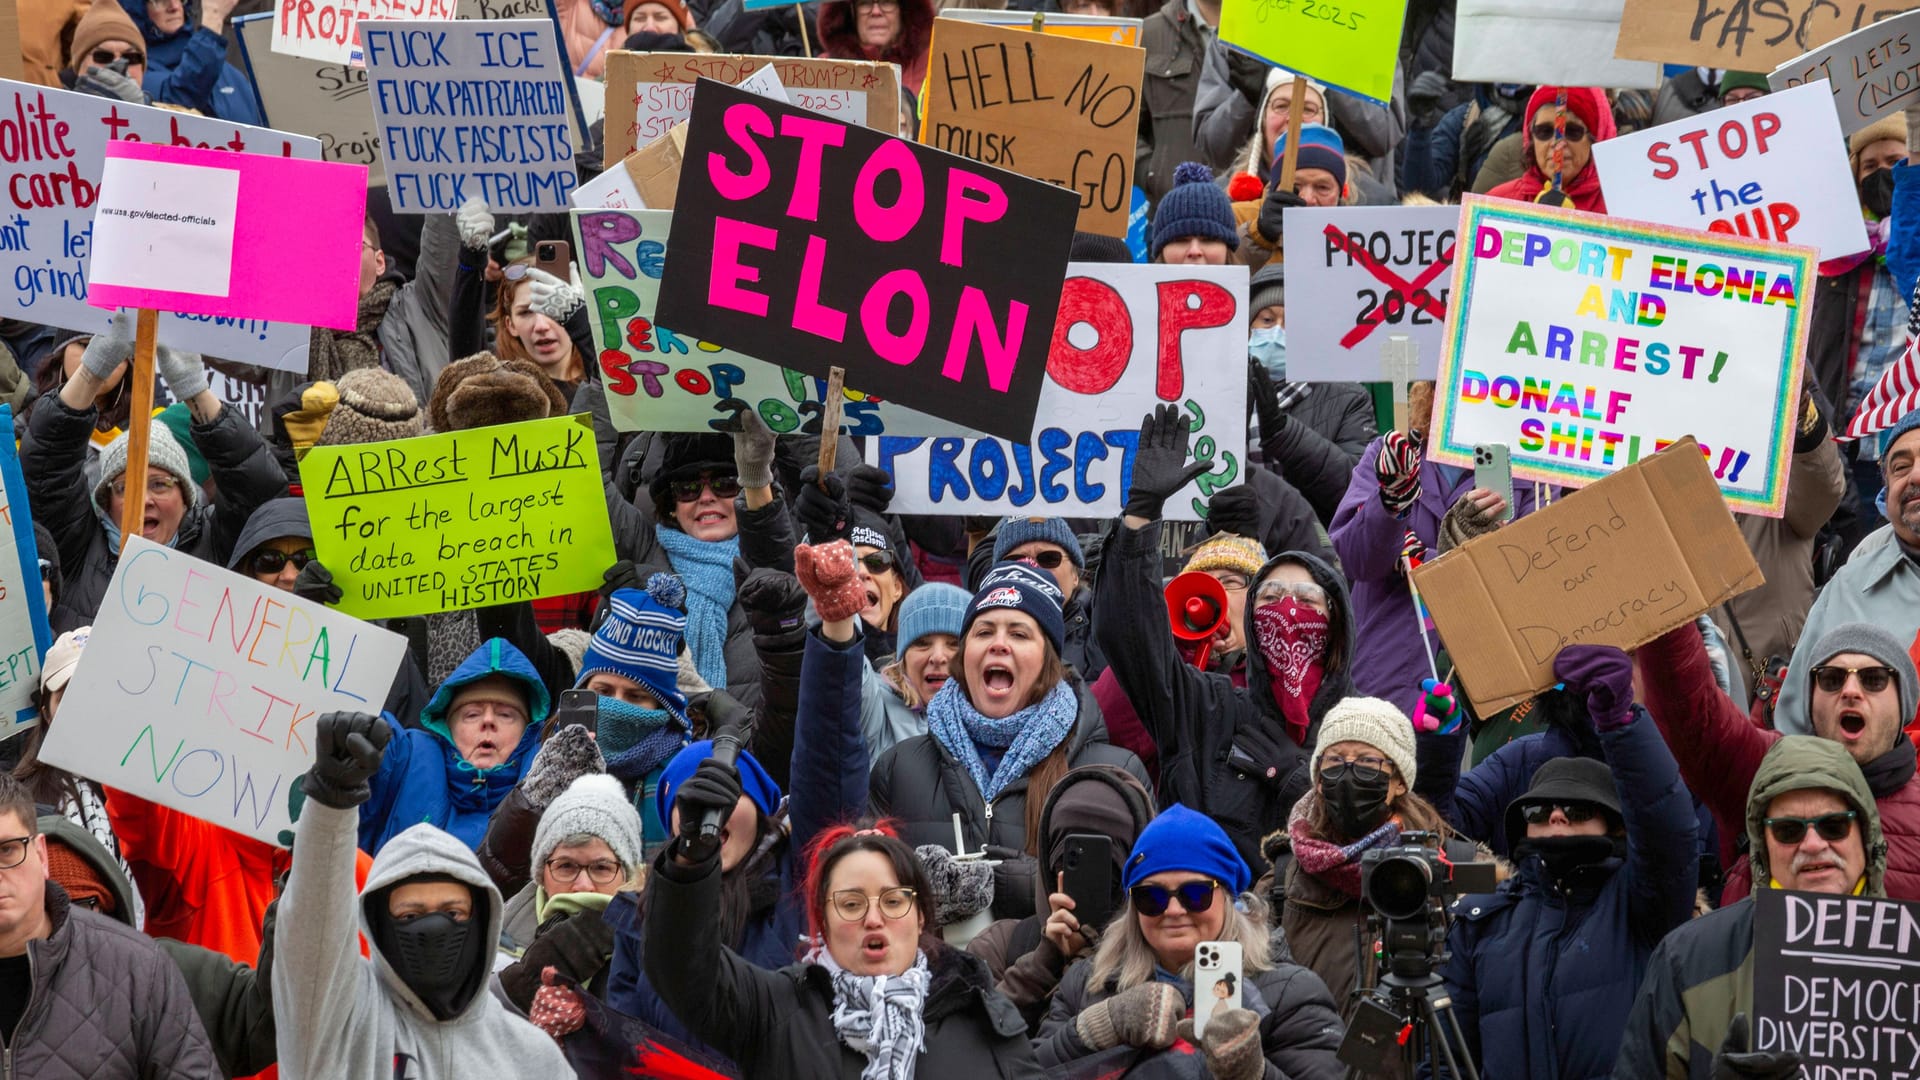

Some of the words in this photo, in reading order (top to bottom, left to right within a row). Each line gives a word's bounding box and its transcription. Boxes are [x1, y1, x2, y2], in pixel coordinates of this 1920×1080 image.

[479, 0, 543, 19] Back!
[1301, 0, 1367, 31] 2025
[368, 31, 451, 68] FUCK
[475, 31, 545, 69] ICE
[677, 59, 756, 84] STOP
[774, 63, 856, 89] TRUMP!
[1853, 32, 1912, 80] LETS
[377, 79, 446, 116] FUCK
[943, 41, 1055, 112] HELL
[1064, 64, 1136, 129] NO
[386, 126, 452, 163] FUCK
[454, 124, 573, 165] FASCISTS
[1647, 112, 1782, 181] STOP
[9, 161, 101, 211] carb
[395, 172, 468, 209] FUCK
[472, 170, 577, 208] TRUMP
[707, 103, 1009, 268] STOP
[1071, 149, 1126, 213] GO
[1690, 178, 1764, 216] the
[1473, 225, 1633, 282] DEPORT
[1649, 254, 1798, 309] ELONIA
[707, 216, 1030, 393] ELON
[1575, 284, 1667, 328] AND
[600, 348, 746, 399] STOP
[1504, 320, 1730, 384] ARREST!
[1460, 368, 1633, 425] DONALF
[877, 426, 1142, 509] PROJECT
[335, 505, 391, 541] for
[405, 498, 453, 531] the
[468, 480, 565, 523] largest
[350, 541, 416, 574] data
[438, 521, 535, 561] breach
[549, 521, 573, 545] in
[1497, 497, 1627, 585] Defend
[362, 571, 447, 601] UNITED
[460, 552, 559, 585] STATES
[441, 573, 542, 609] HISTORY
[1563, 564, 1598, 592] our
[120, 549, 368, 703] GENERAL
[1517, 580, 1689, 666] Democracy
